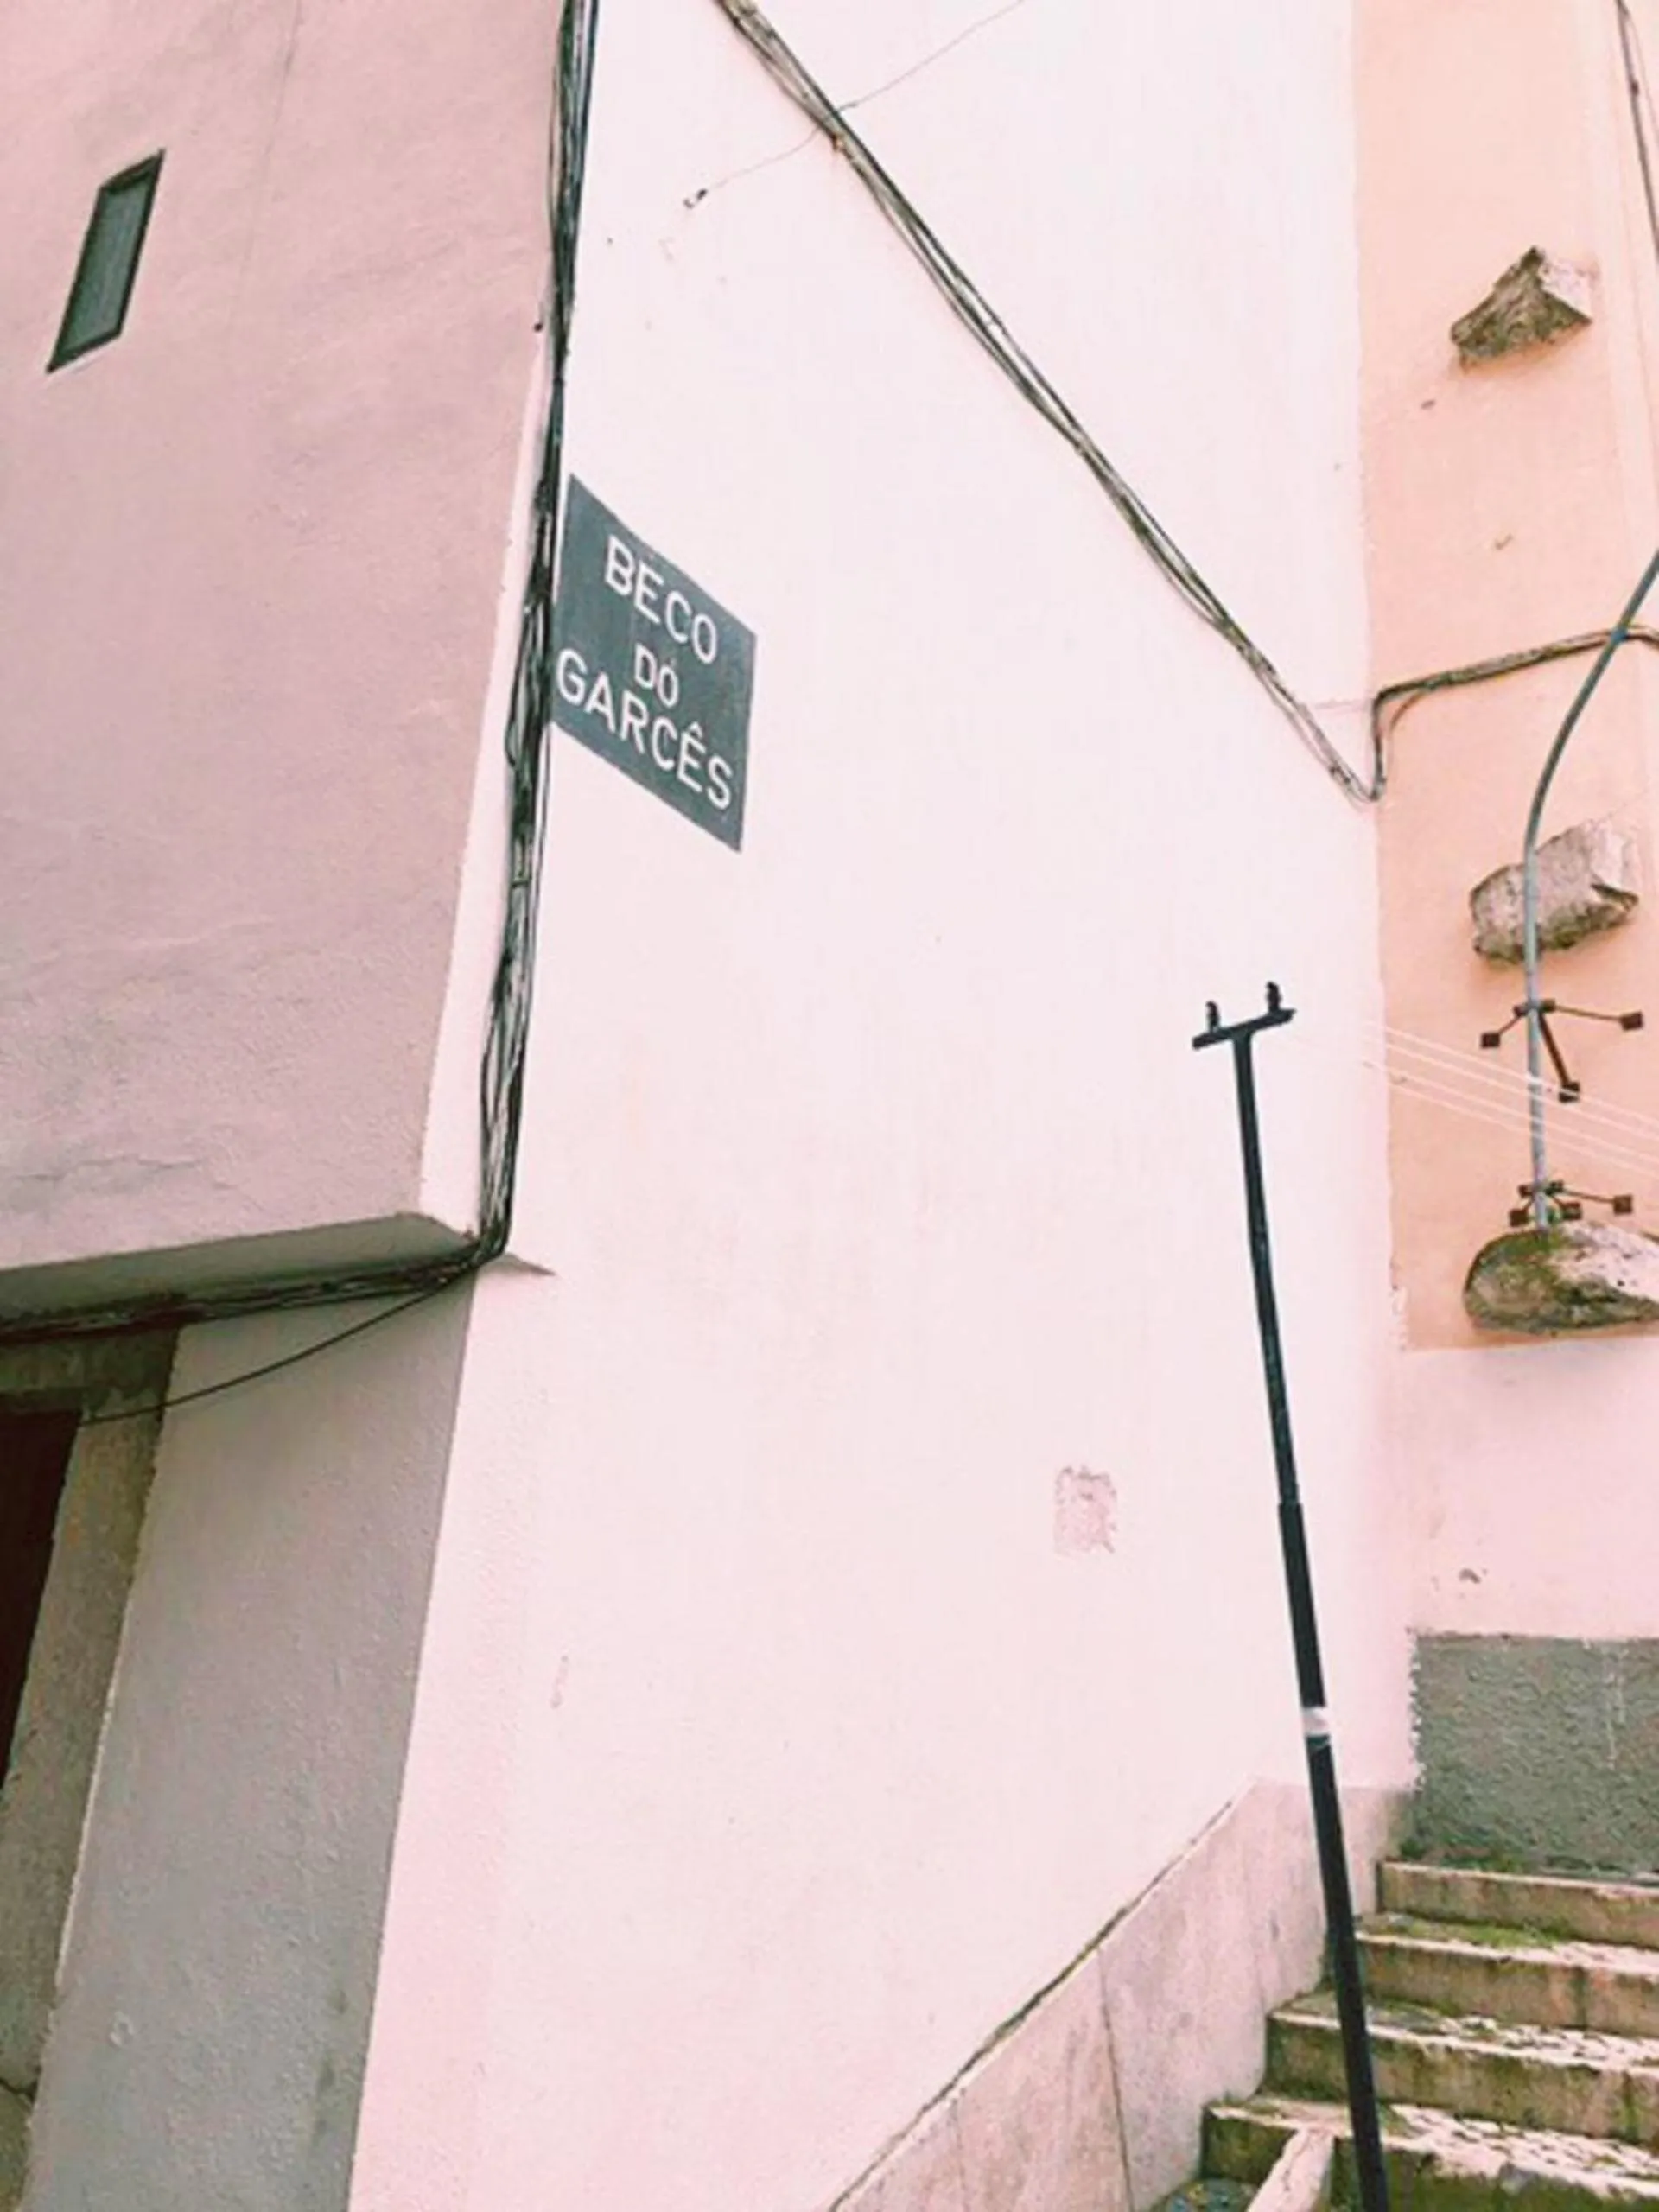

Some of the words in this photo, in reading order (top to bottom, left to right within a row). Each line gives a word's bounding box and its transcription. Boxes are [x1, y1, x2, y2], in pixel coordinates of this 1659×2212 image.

[605, 533, 717, 664] BECO
[556, 648, 732, 810] GARCÊS
[633, 644, 678, 708] DO
